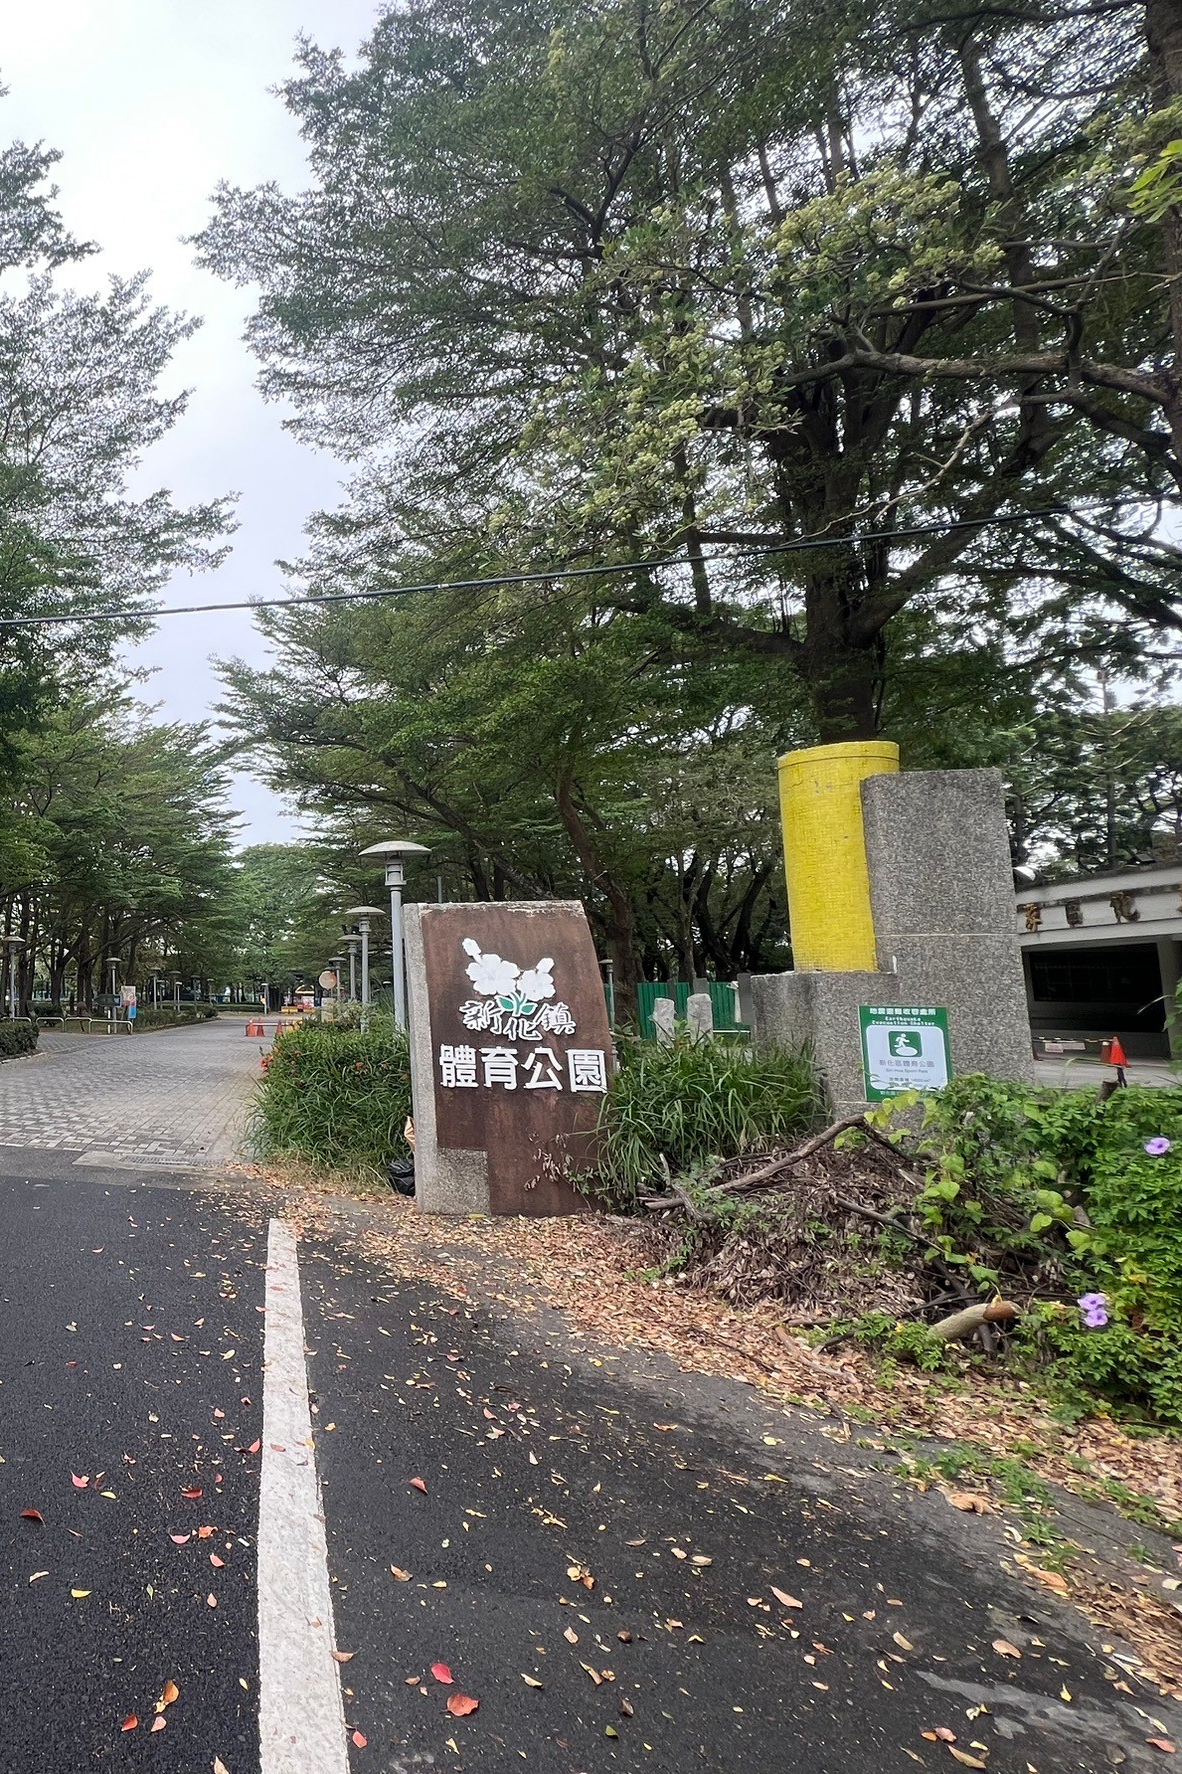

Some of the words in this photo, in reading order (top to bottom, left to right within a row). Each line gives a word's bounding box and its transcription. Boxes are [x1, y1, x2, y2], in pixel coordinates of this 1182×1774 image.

[459, 1000, 576, 1041] 新化鎮
[439, 1043, 608, 1094] 體育公園
